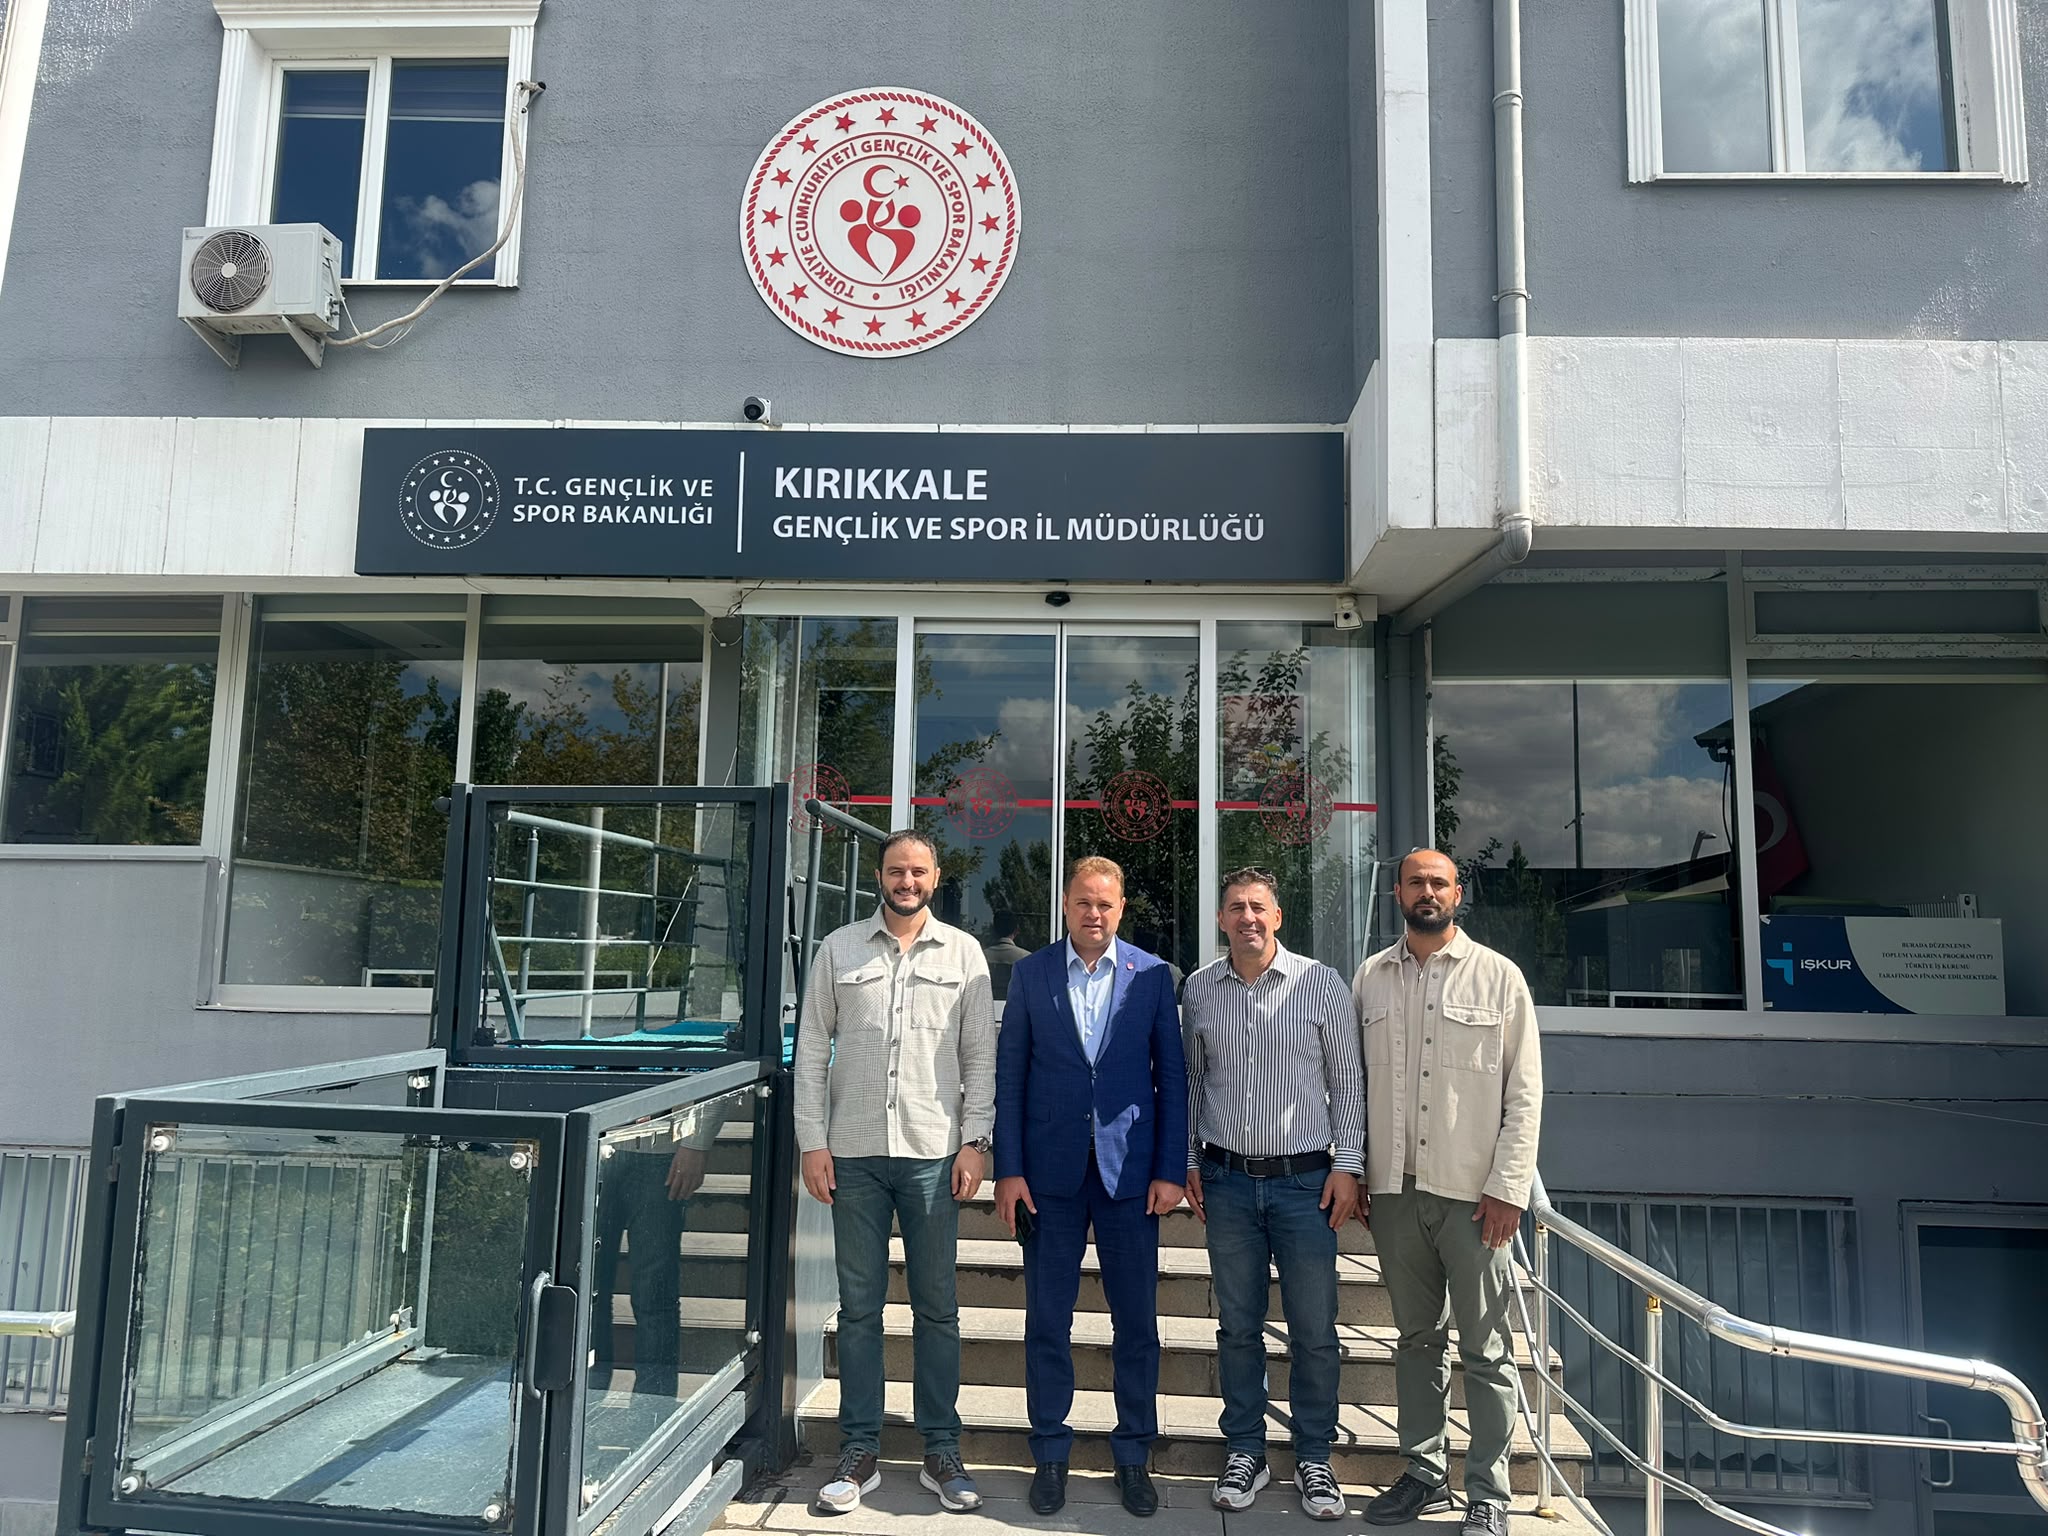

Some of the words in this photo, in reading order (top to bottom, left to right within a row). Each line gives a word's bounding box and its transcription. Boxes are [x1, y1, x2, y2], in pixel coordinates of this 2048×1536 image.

[861, 139, 934, 165] GENÇLİK
[932, 159, 952, 181] VE
[795, 141, 857, 242] CUMHURİYETİ
[944, 180, 965, 224] SPOR
[800, 244, 855, 299] TÜRKİYE
[898, 228, 964, 299] BAKANLIĞI
[514, 476, 557, 497] T.C.
[564, 474, 674, 502] GENÇLİK
[682, 477, 714, 497] VE
[774, 466, 989, 501] KIRIKKALE
[511, 504, 577, 524] SPOR
[582, 501, 714, 525] BAKANLIĞI
[771, 511, 900, 545] GENÇLİK
[905, 516, 942, 540] VE
[949, 516, 1028, 541] SPOR
[1035, 511, 1060, 542] İL
[1066, 511, 1266, 543] MÜDÜRLÜĞÜ
[1800, 959, 1852, 971] İŞKUR
